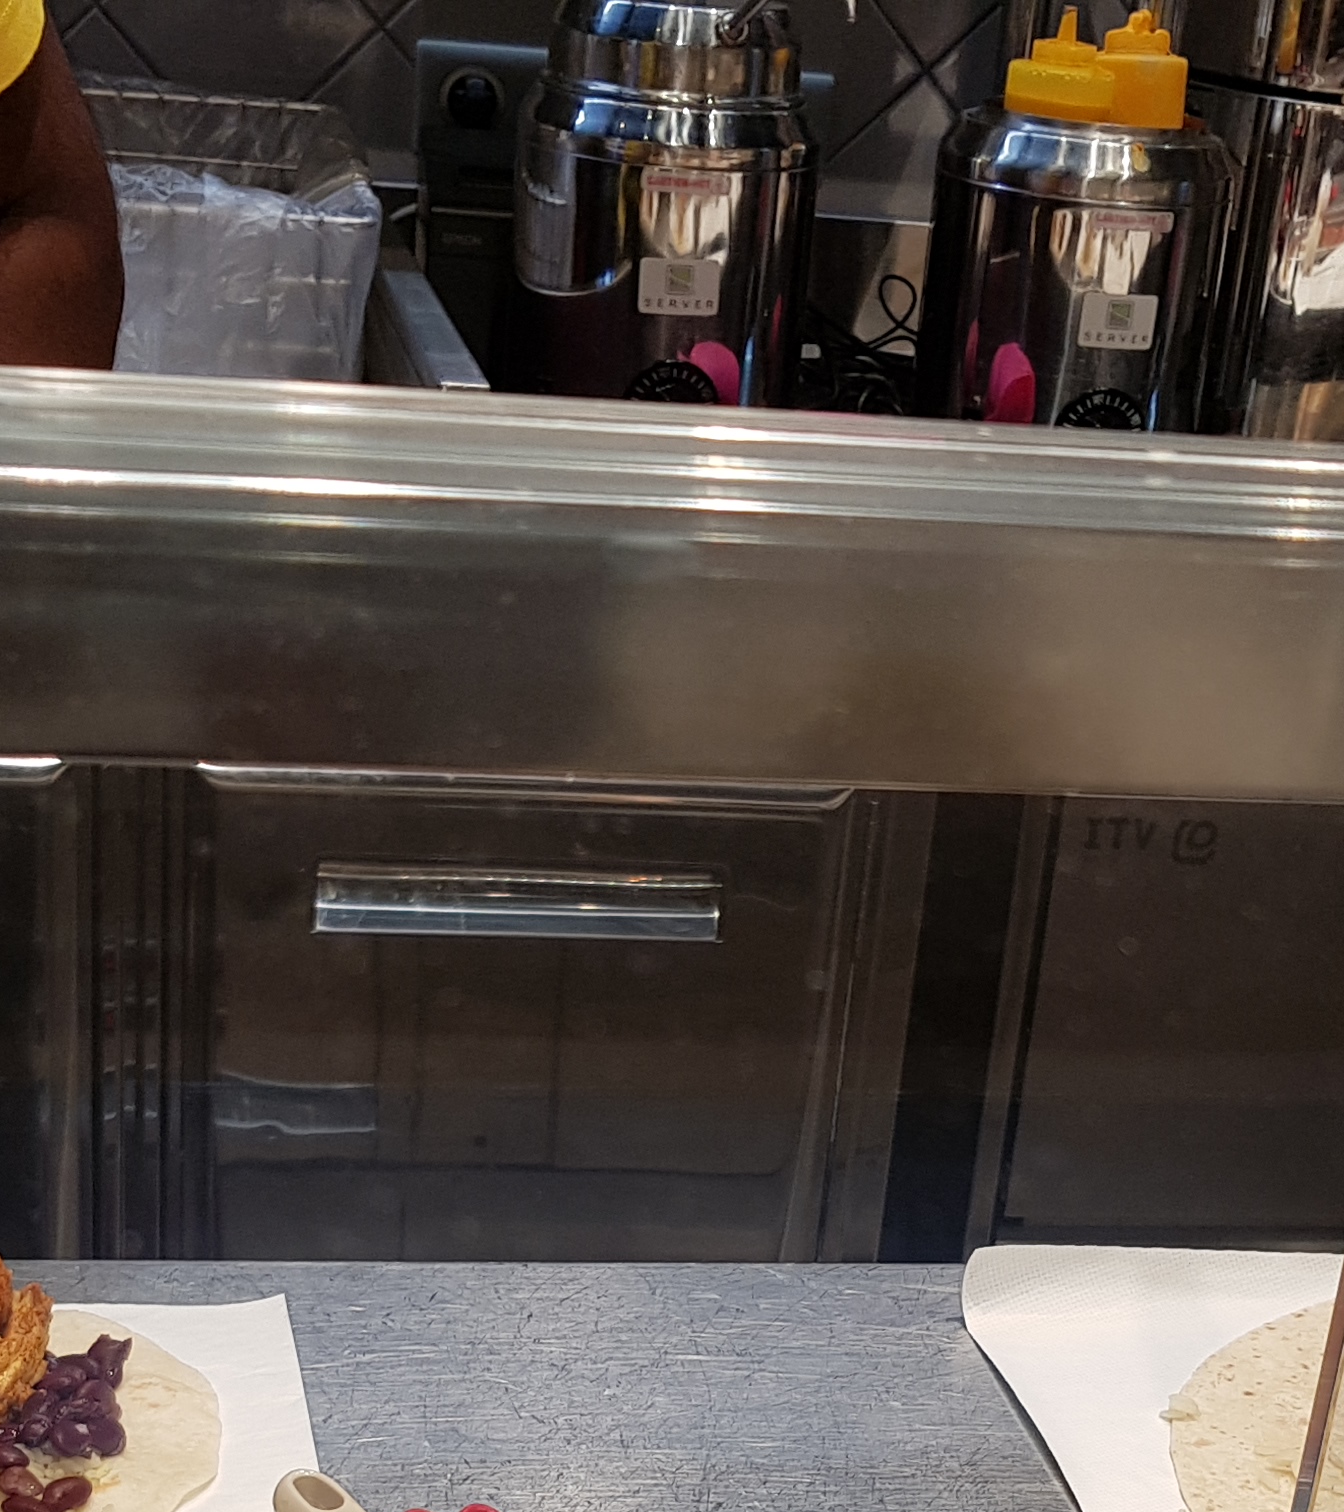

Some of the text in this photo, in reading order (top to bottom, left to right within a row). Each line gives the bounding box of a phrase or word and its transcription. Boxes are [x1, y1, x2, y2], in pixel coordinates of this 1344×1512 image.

[643, 298, 715, 310] SERVER
[1084, 331, 1150, 344] SERVER
[1084, 816, 1156, 850] ITV
